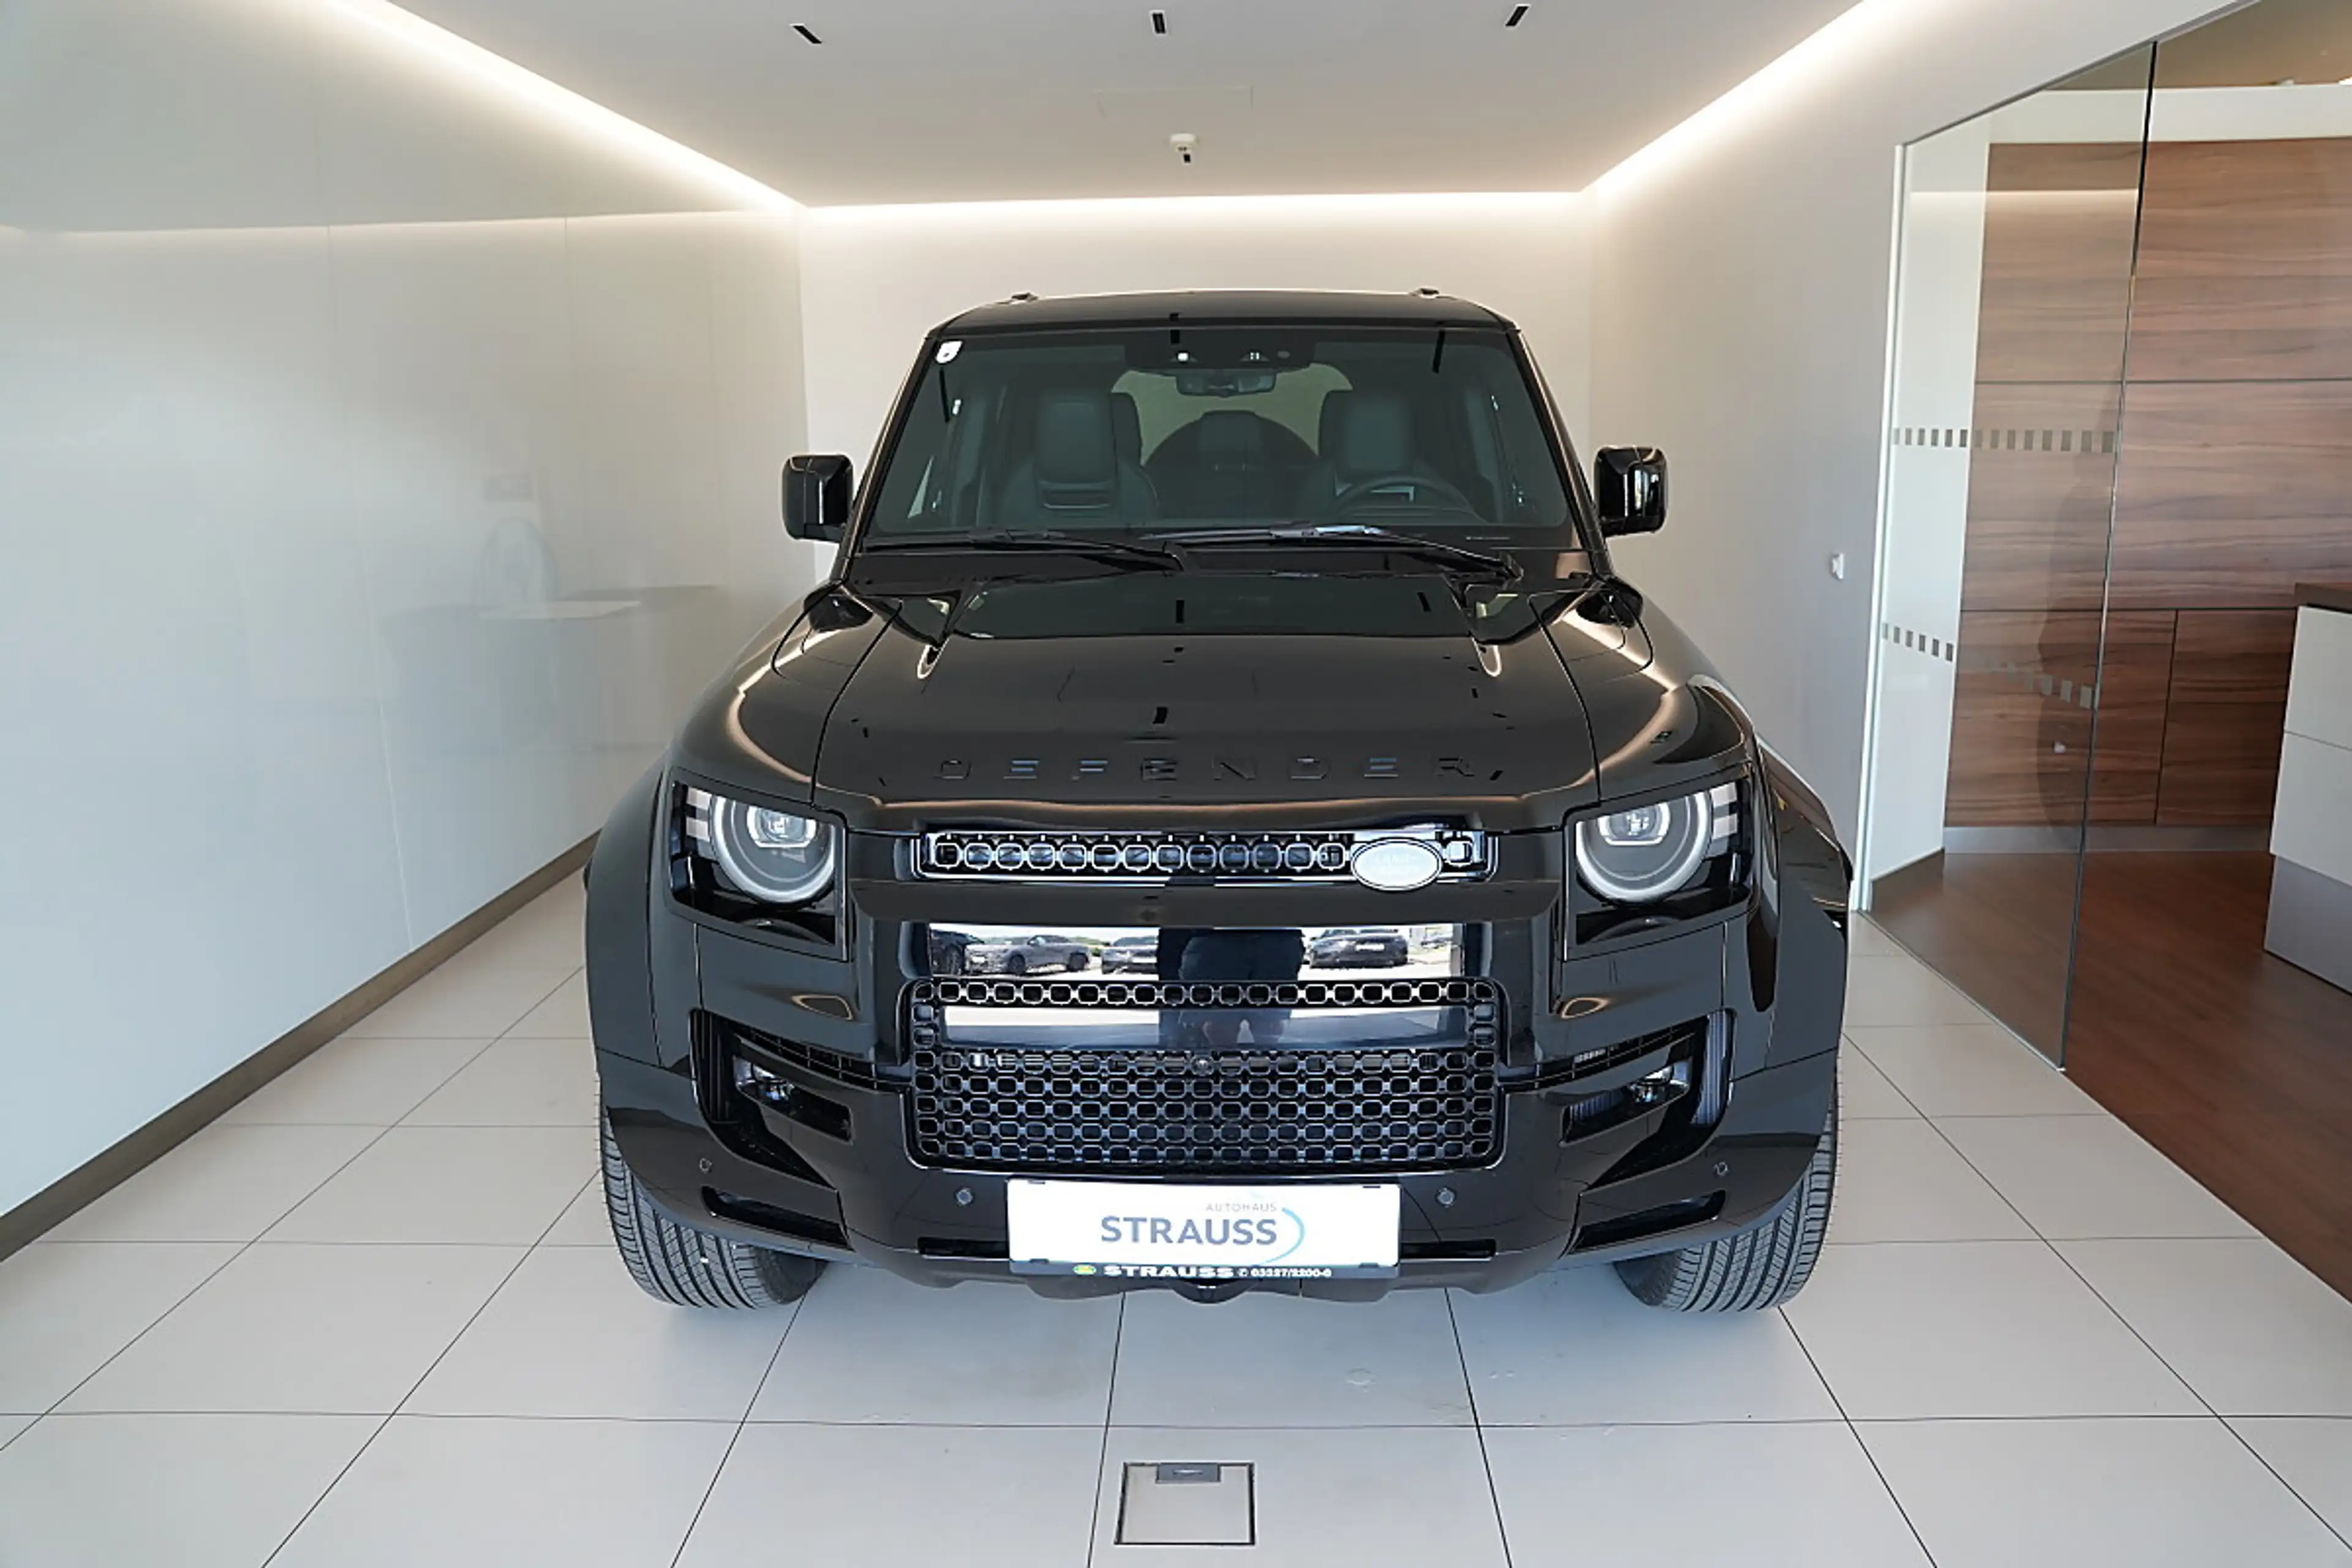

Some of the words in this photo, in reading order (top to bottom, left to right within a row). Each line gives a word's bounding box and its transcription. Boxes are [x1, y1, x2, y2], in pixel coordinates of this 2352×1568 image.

[1205, 1202, 1278, 1212] AUTOHAUS
[1101, 1216, 1278, 1245] STRAUSS
[1103, 1265, 1234, 1278] STRAUSS
